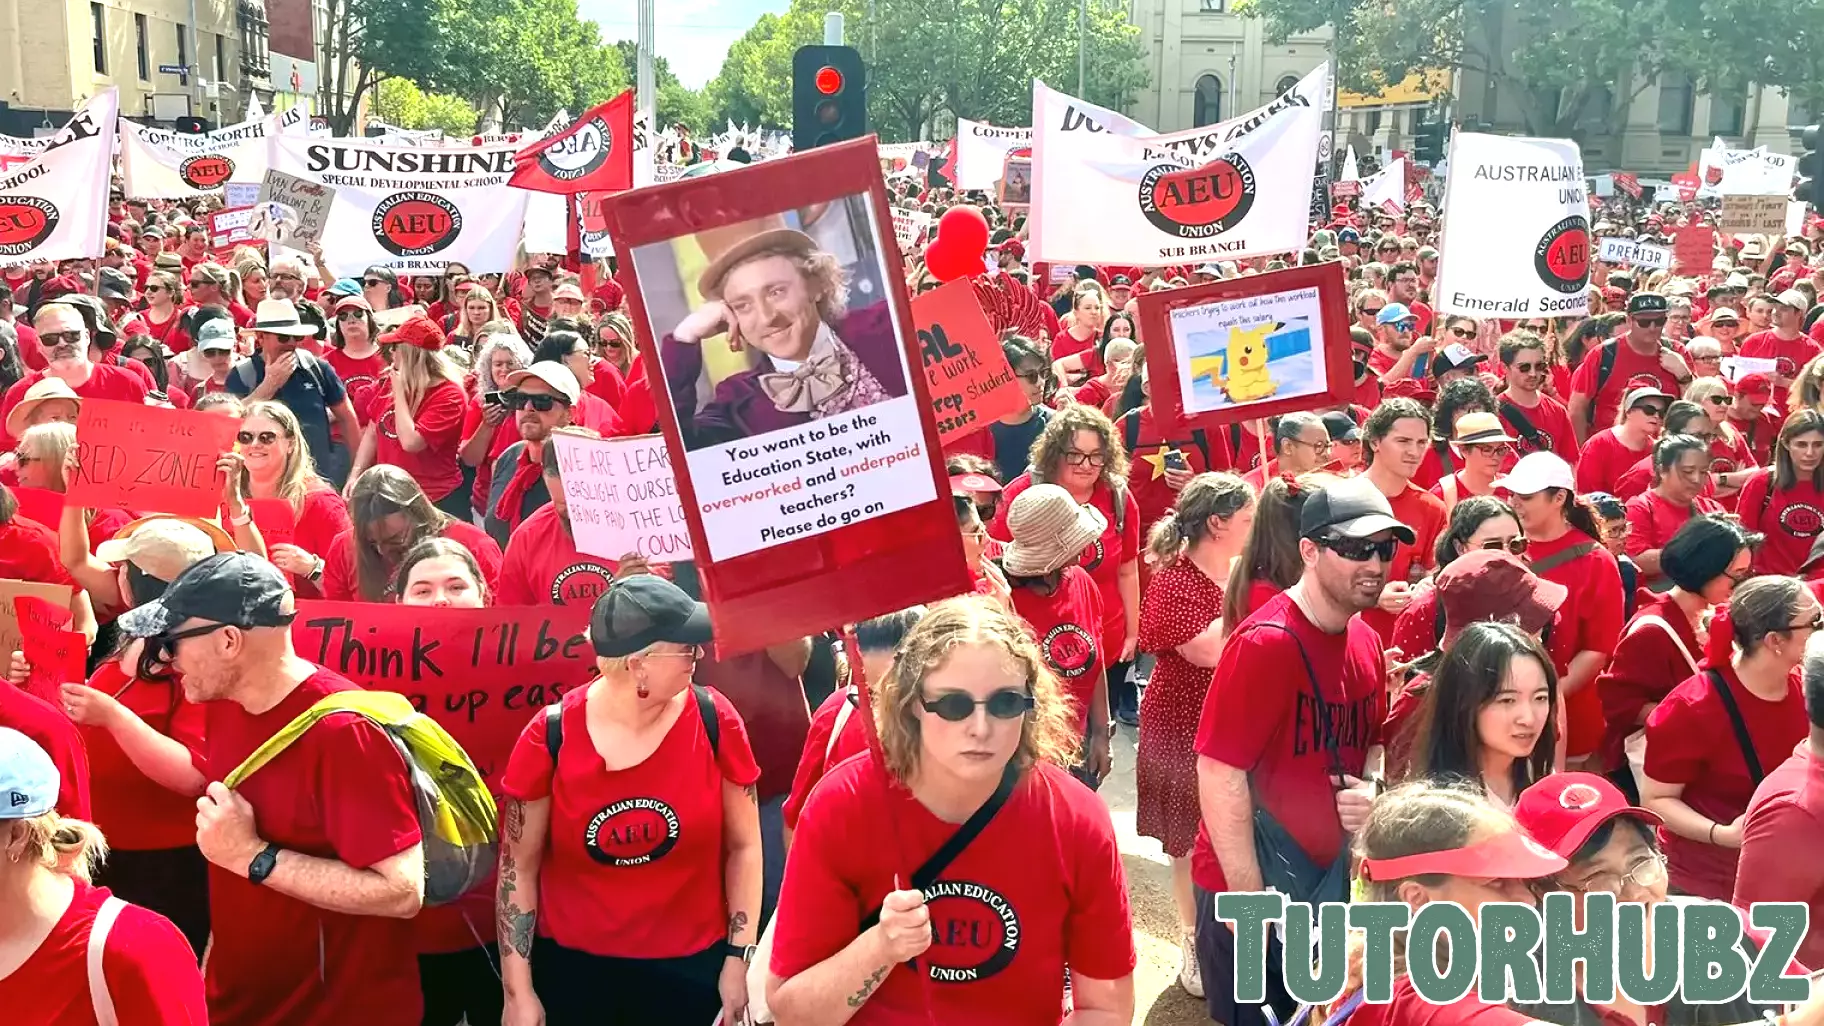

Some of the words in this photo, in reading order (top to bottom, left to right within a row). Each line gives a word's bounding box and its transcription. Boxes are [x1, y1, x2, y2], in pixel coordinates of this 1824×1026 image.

[211, 122, 265, 144] NORTH
[190, 163, 229, 178] AEU
[306, 144, 517, 174] SUNSHINE
[1473, 164, 1576, 182] AUSTRALIAN
[321, 173, 367, 188] SPECIAL
[370, 177, 460, 190] DEVELOPMENTAL
[463, 175, 506, 189] SCHOOL
[1159, 170, 1237, 208] AEU
[373, 191, 416, 237] AUSTRALIAN
[416, 191, 462, 230] EDUCATION
[388, 213, 447, 234] AEU
[1178, 220, 1225, 237] UNION
[400, 244, 436, 257] UNION
[1158, 245, 1185, 258] SUB
[1189, 238, 1247, 256] BRANCH
[1552, 243, 1588, 266] AEU
[407, 260, 451, 270] BRANCH
[1452, 291, 1530, 313] Emerald
[941, 343, 983, 380] work
[725, 446, 759, 463] You
[762, 432, 806, 454] want
[809, 428, 826, 443] to
[828, 422, 849, 437] be
[851, 414, 878, 431] the
[74, 440, 127, 487] RED
[557, 444, 584, 473] WE
[590, 449, 616, 477] ARE
[721, 457, 803, 486] Education
[805, 444, 854, 466] State,
[856, 430, 892, 451] with
[701, 476, 802, 514] overworked
[805, 468, 837, 488] and
[840, 442, 922, 478] underpaid
[779, 483, 856, 516] teachers?
[629, 507, 663, 530] THE
[760, 522, 813, 543] Please
[816, 513, 838, 529] do
[840, 508, 861, 525] go
[864, 500, 885, 515] on
[305, 616, 444, 681] Think
[471, 621, 520, 667] I'll
[533, 619, 588, 662] be
[444, 689, 490, 723] up
[503, 681, 578, 710] eas
[586, 798, 634, 848] AUSTRALIAN
[634, 798, 679, 839] EDUCATION
[605, 820, 659, 848] AEU
[614, 854, 651, 866] UNION
[963, 883, 1019, 951] EDUCATION
[929, 965, 978, 982] UNION
